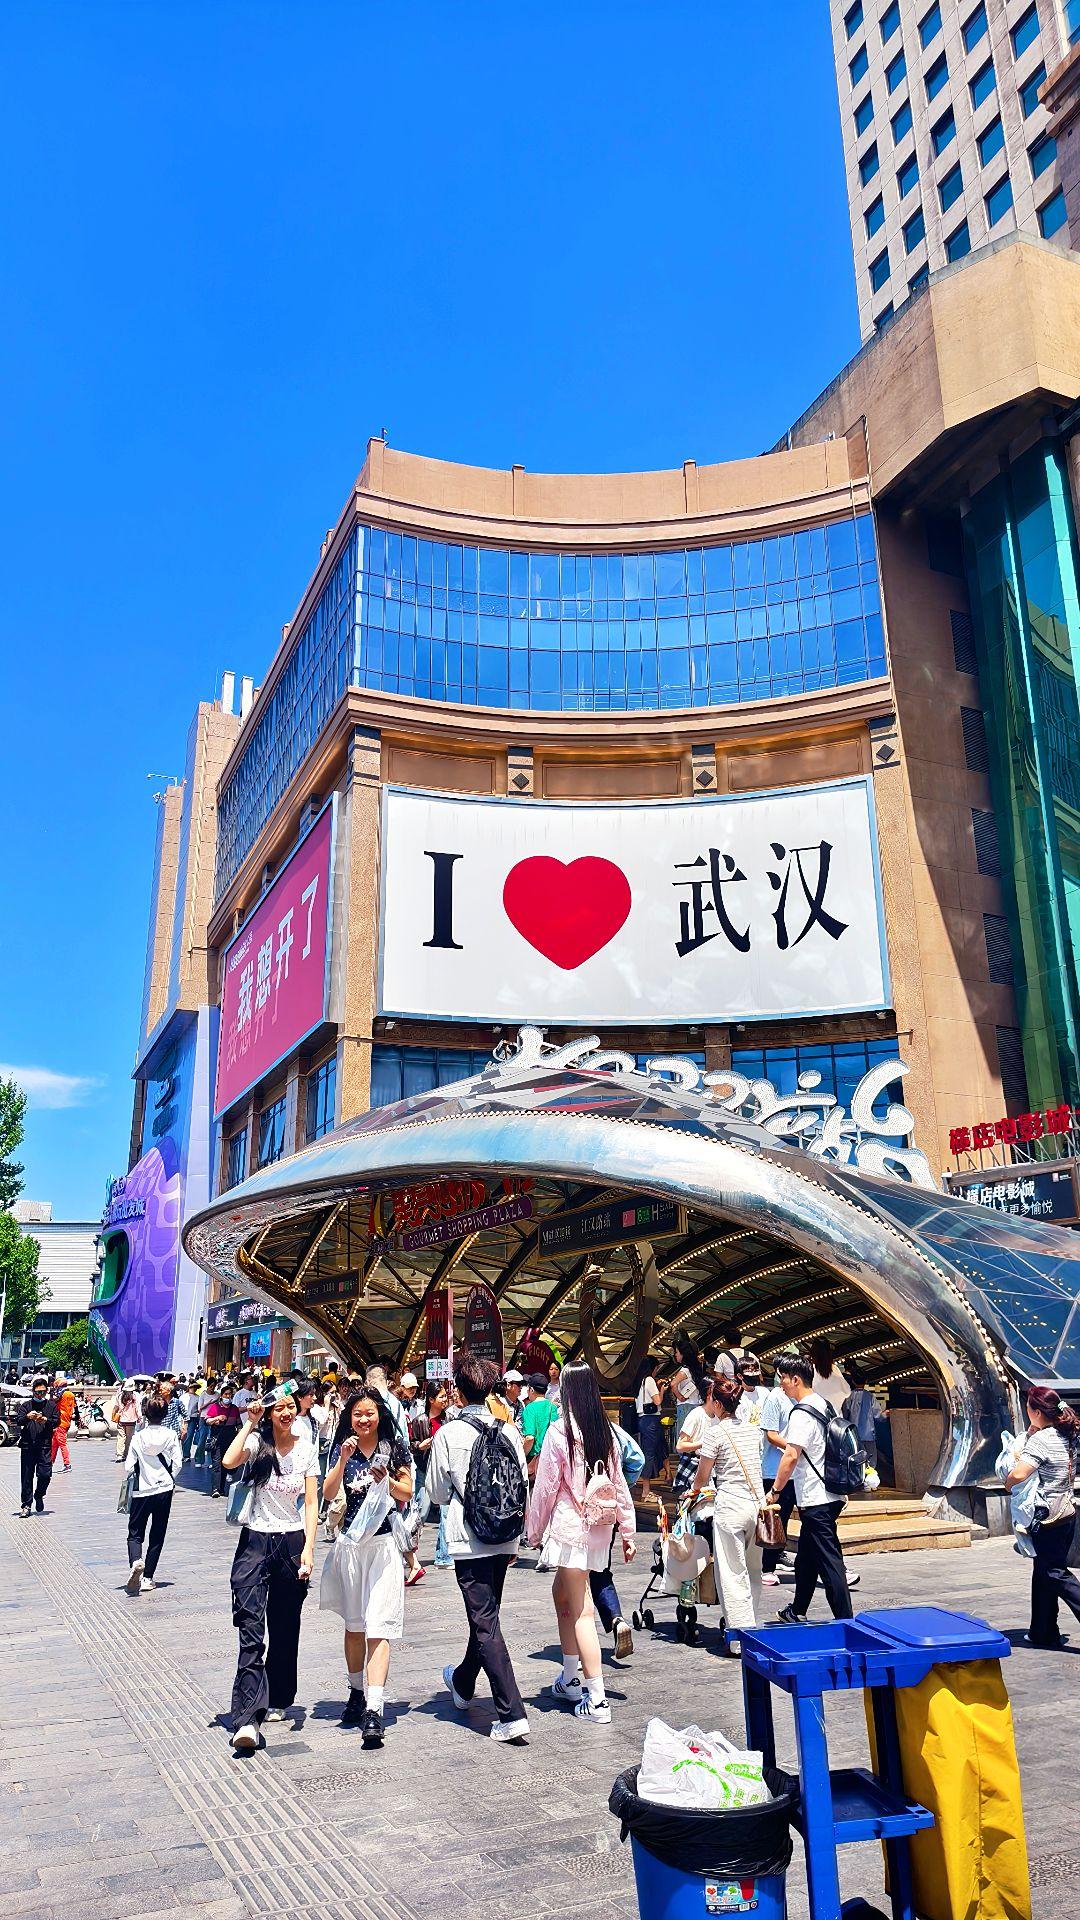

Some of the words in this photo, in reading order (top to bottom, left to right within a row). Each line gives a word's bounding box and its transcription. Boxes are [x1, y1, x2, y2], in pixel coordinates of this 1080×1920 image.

[423, 851, 463, 949] I
[672, 840, 849, 957] 武汉
[238, 874, 319, 1033] 我想开了
[949, 1104, 1072, 1155] 横店电影城
[966, 1182, 1035, 1204] 横店电影城
[408, 1226, 443, 1247] GOURMET
[447, 1212, 490, 1237] SHOPPING
[492, 1203, 524, 1222] PLAZA
